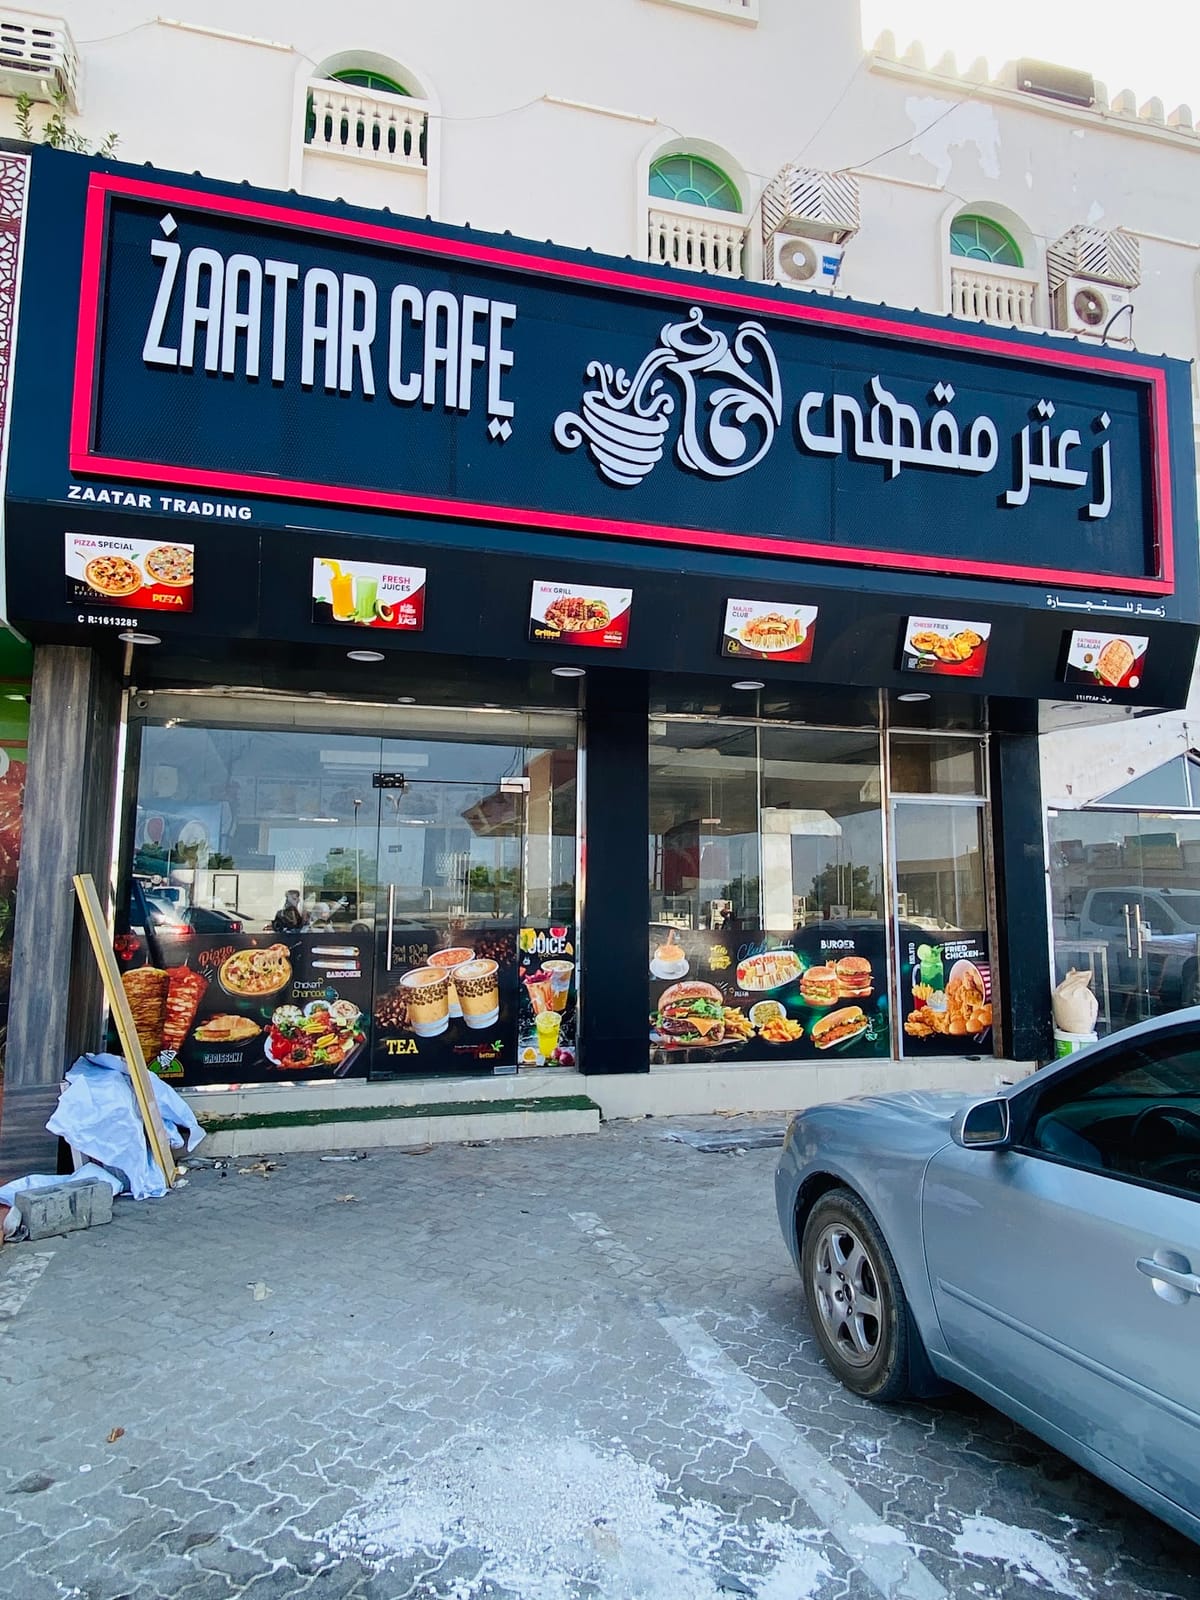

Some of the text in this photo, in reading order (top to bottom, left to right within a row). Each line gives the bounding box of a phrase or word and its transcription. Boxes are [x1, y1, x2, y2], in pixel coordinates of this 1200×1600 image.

[67, 485, 252, 520] ZAATAR TRADING
[73, 538, 134, 551] PIZZA SPECIAL
[382, 575, 411, 585] FRESH
[381, 583, 411, 592] JUICES
[553, 587, 572, 595] GRILL
[152, 593, 184, 605] PIZZA
[1134, 603, 1166, 617] زعتر
[528, 936, 566, 954] JUICE
[820, 939, 855, 950] BURGER
[944, 945, 968, 953] FRIED
[944, 950, 979, 960] CHICKEN
[293, 981, 322, 989] Chicken
[386, 1038, 419, 1055] TEA
